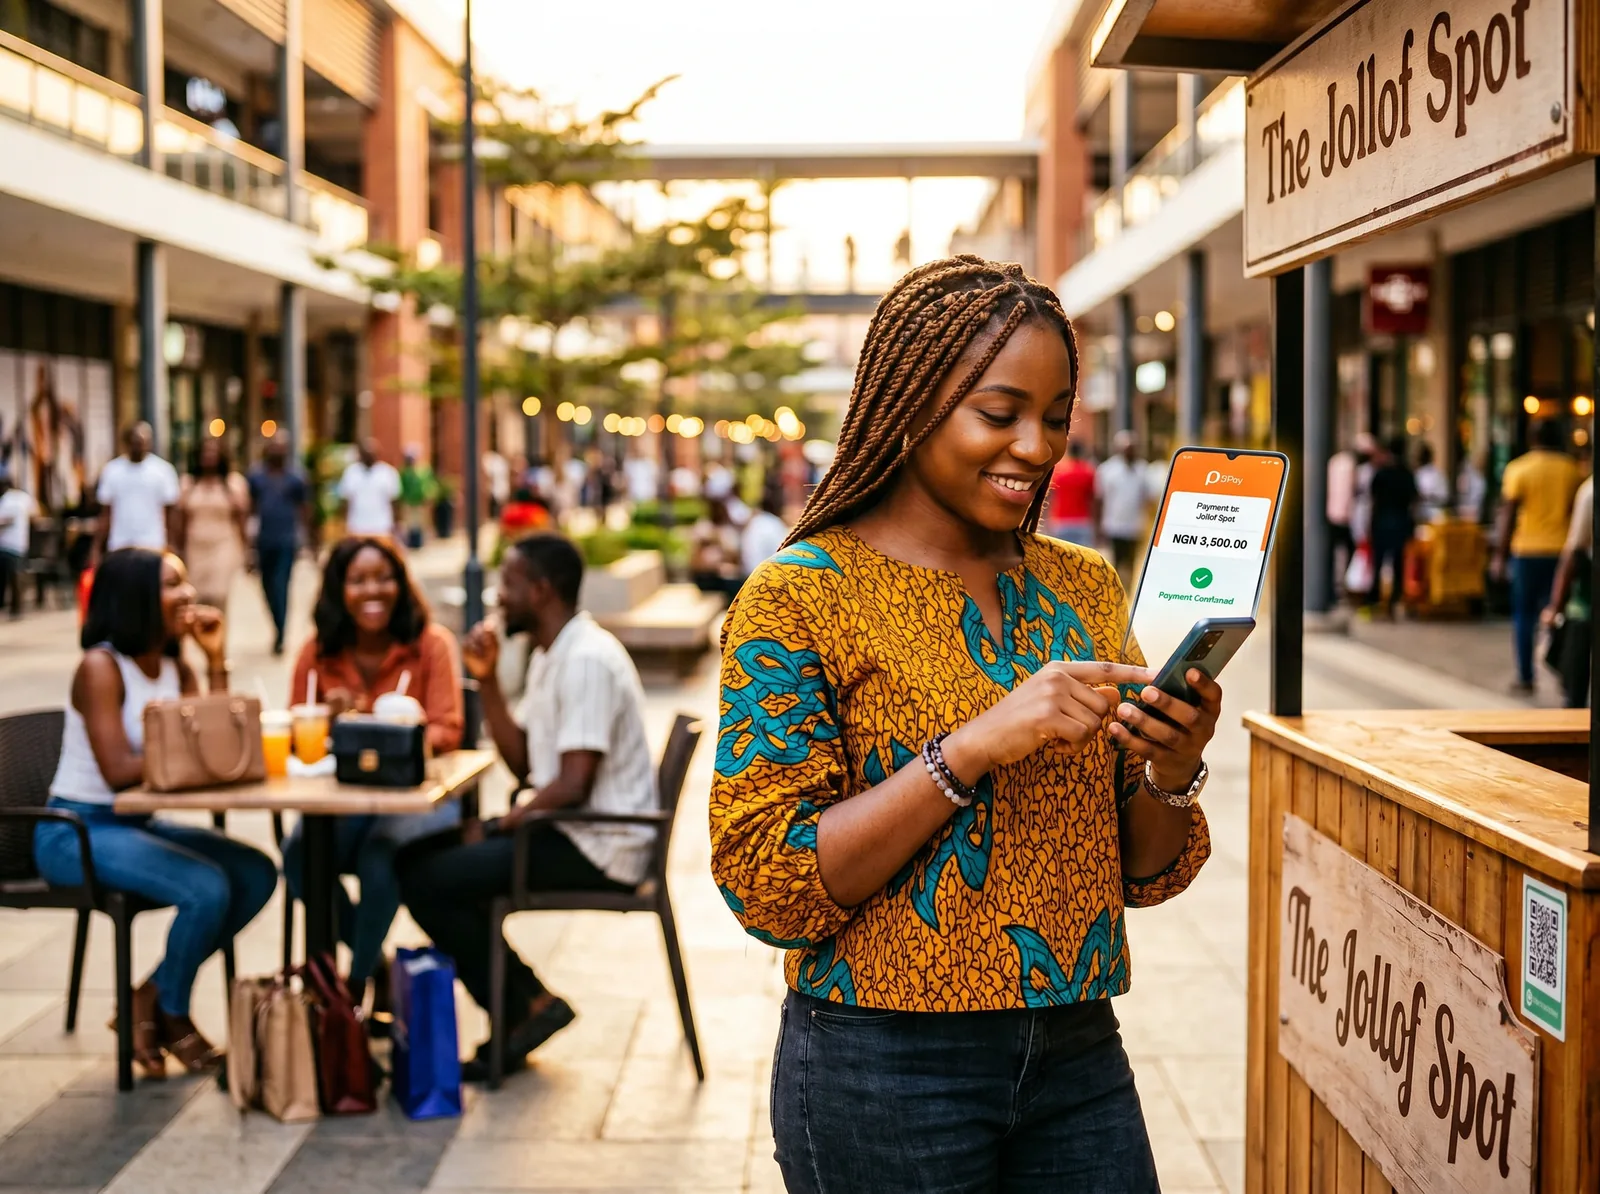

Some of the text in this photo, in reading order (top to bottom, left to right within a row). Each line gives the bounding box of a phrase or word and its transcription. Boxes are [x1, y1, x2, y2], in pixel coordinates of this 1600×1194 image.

[1262, 0, 1531, 204] The Jollof Spot
[1196, 502, 1229, 512] Payment
[1217, 514, 1236, 523] Spot
[1172, 533, 1248, 550] NGN 3,500.00
[1158, 591, 1193, 601] Payment
[1288, 885, 1516, 1179] The Jollof Spot
